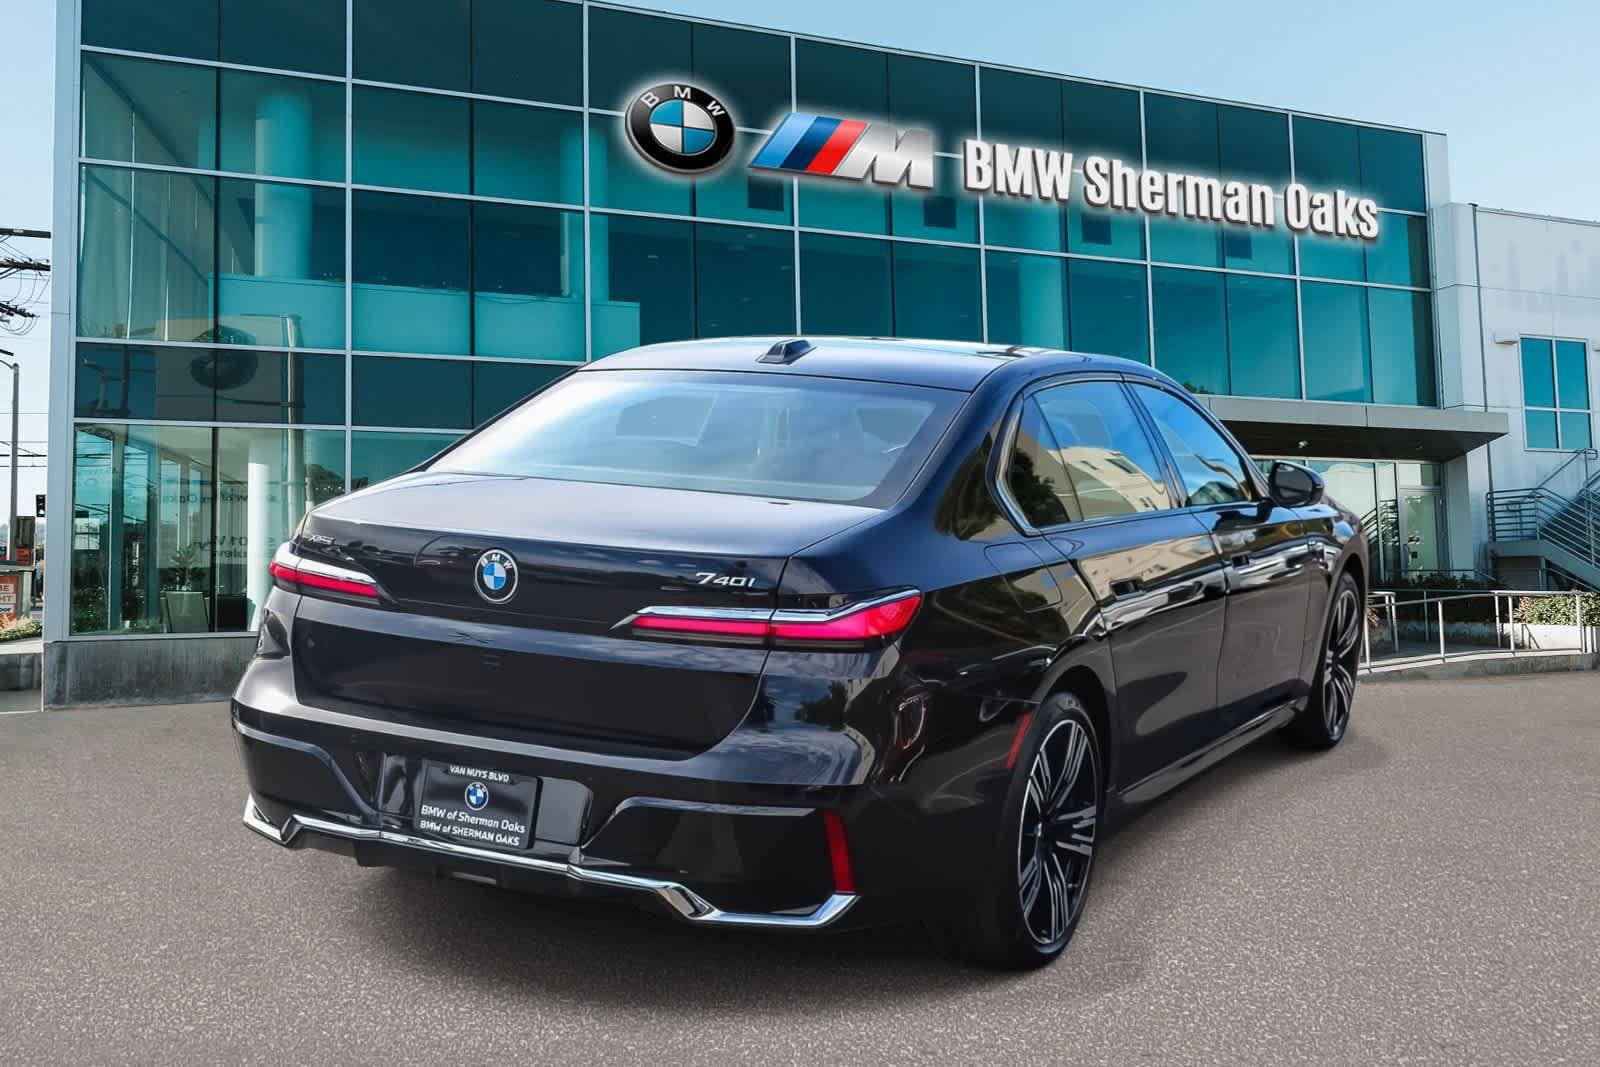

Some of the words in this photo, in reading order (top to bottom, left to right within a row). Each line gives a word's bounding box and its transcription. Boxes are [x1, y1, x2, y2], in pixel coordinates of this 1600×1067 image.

[640, 85, 726, 117] BMW
[963, 139, 1073, 200] BMW
[1083, 155, 1275, 226] Sherman
[1284, 183, 1379, 239] Oaks
[480, 553, 513, 569] BMW
[449, 765, 466, 776] VAN
[466, 767, 488, 779] NUYS
[488, 771, 510, 783] BLVD
[420, 804, 446, 818] BMW
[446, 810, 458, 821] of
[458, 811, 499, 829] Sherman
[501, 819, 526, 834] Oaks
[420, 820, 441, 832] BMW
[442, 825, 451, 834] of
[451, 825, 495, 842] SHERMAN
[495, 834, 520, 846] OAKS
